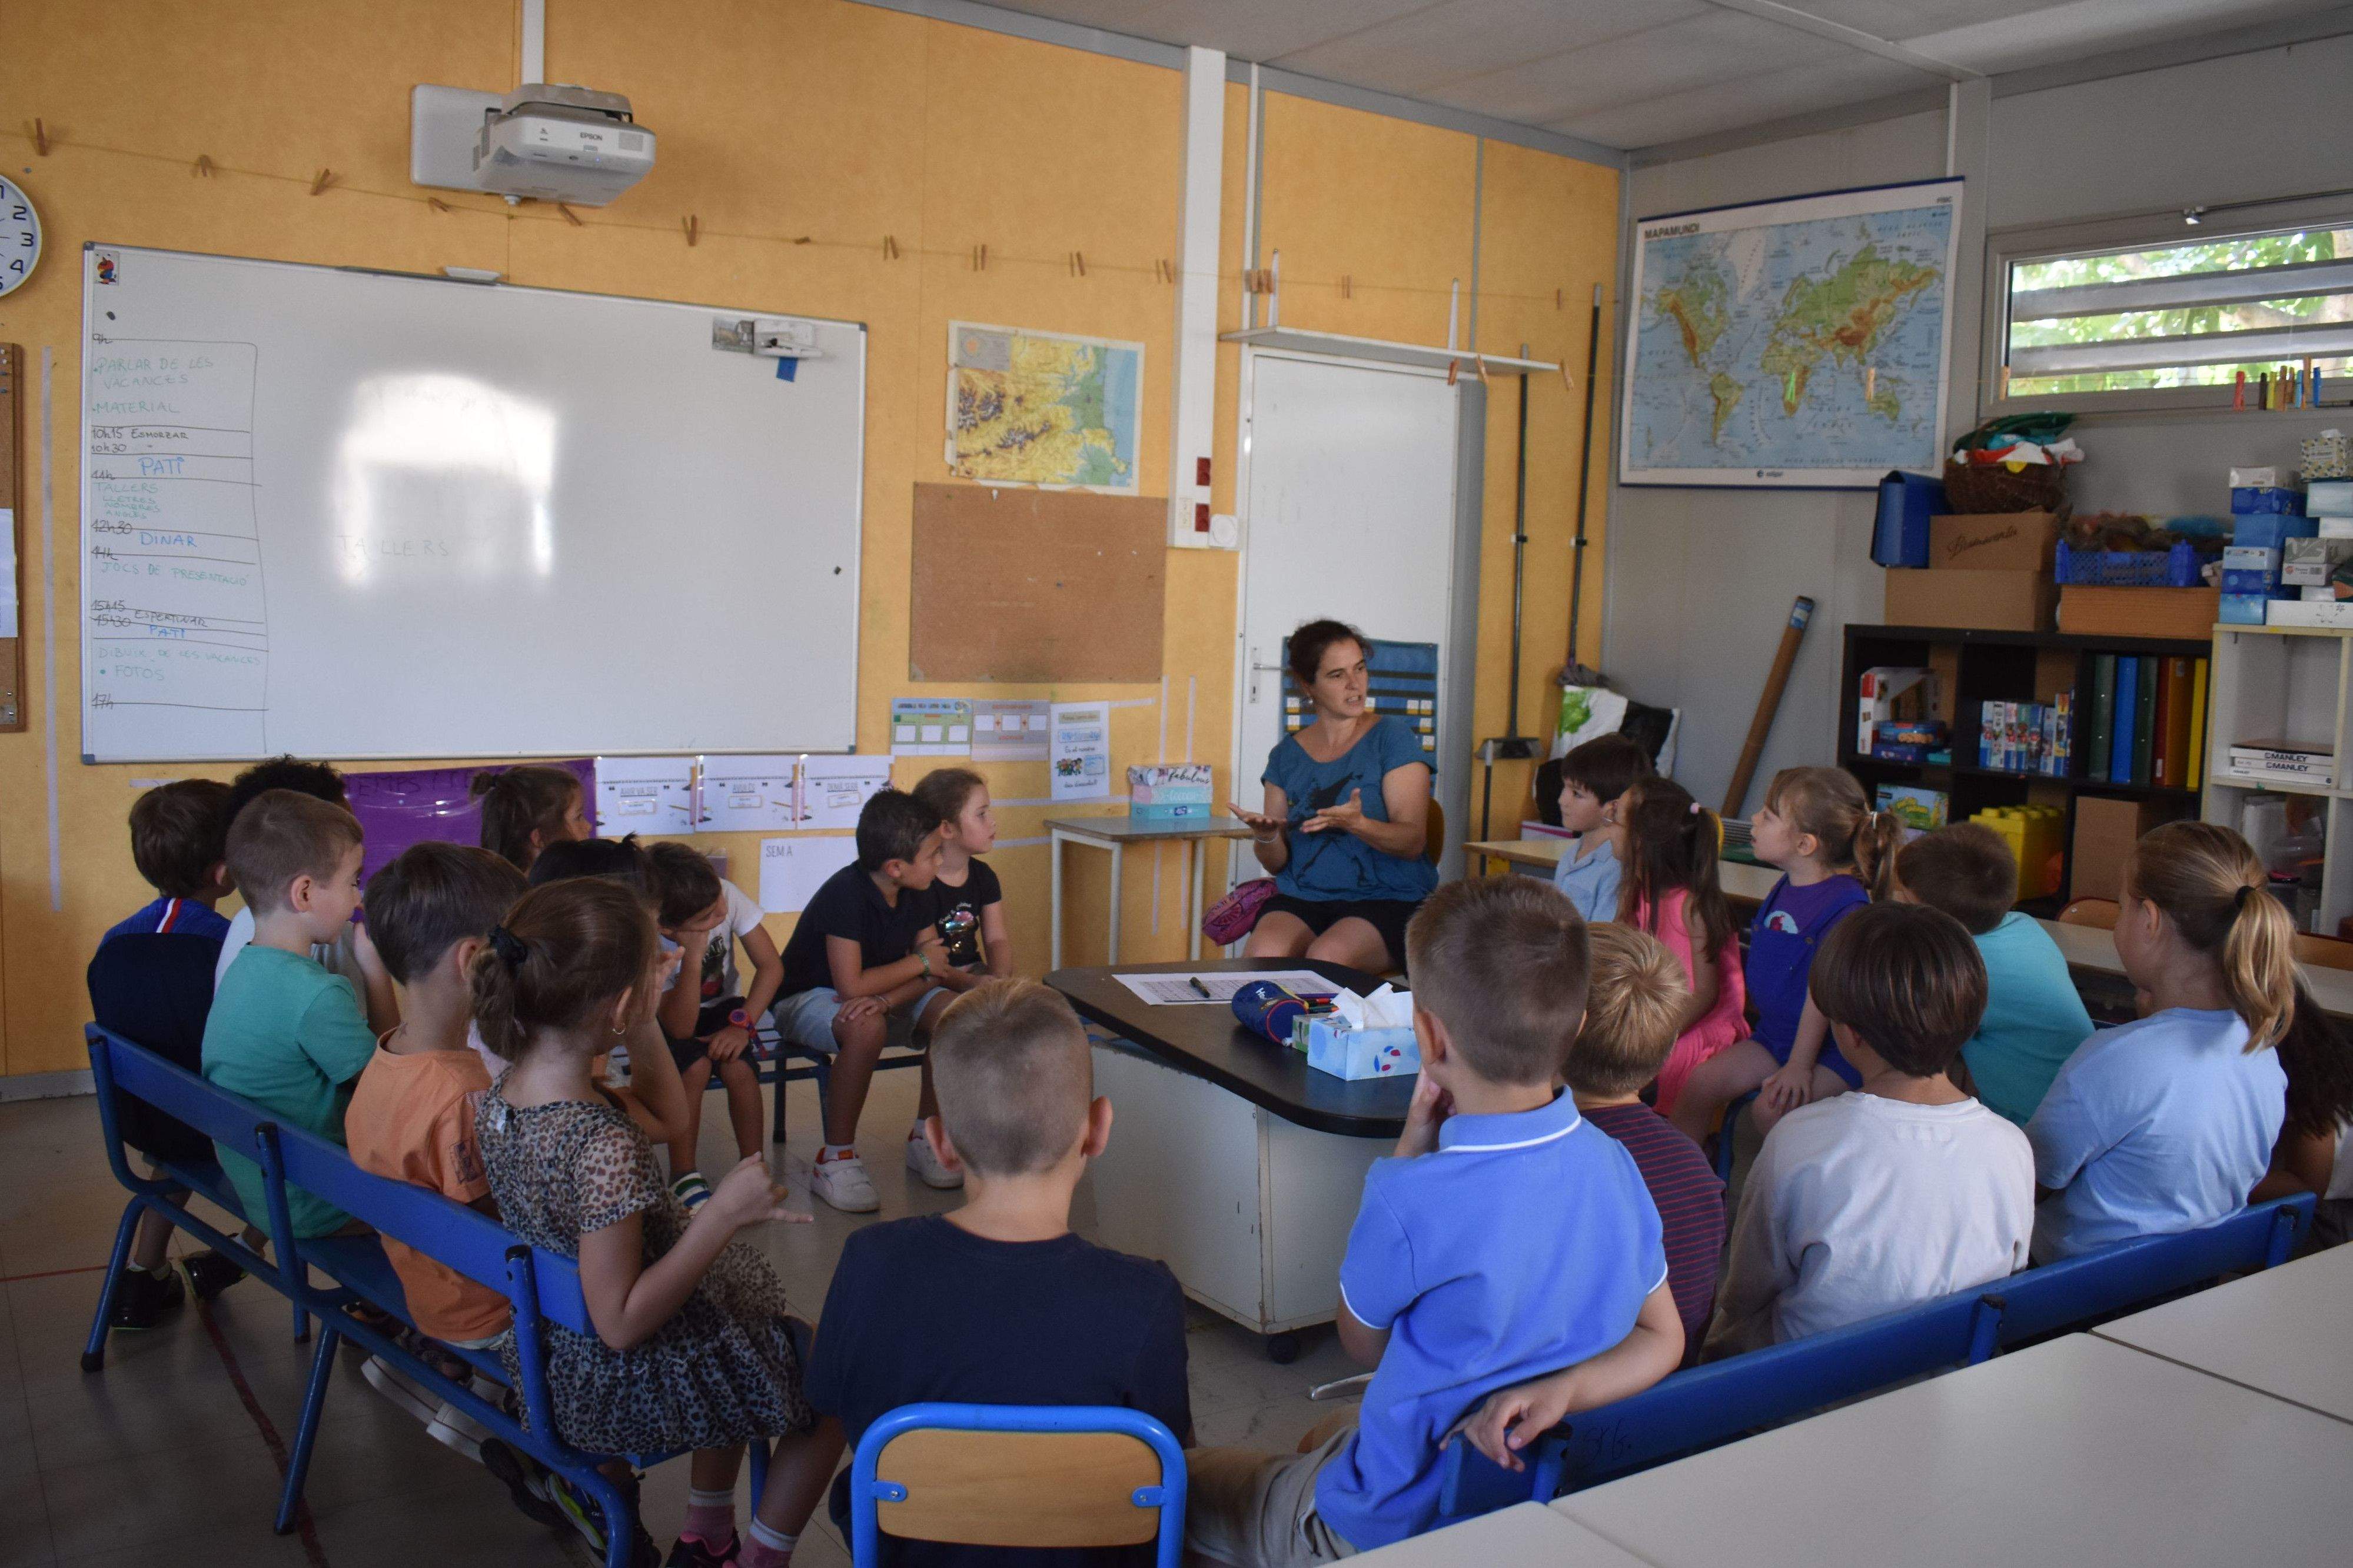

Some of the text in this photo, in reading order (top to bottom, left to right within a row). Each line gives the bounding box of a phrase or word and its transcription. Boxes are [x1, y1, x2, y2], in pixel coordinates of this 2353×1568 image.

[580, 132, 603, 141] EPSON
[13, 205, 27, 221] 2
[21, 232, 34, 247] 3
[10, 259, 24, 274] 4
[160, 358, 177, 369] DE
[189, 357, 213, 368] LES
[96, 401, 181, 413] MATERIAL
[139, 532, 197, 547] DINAR
[115, 665, 165, 681] FOTOS
[766, 845, 785, 857] SEM
